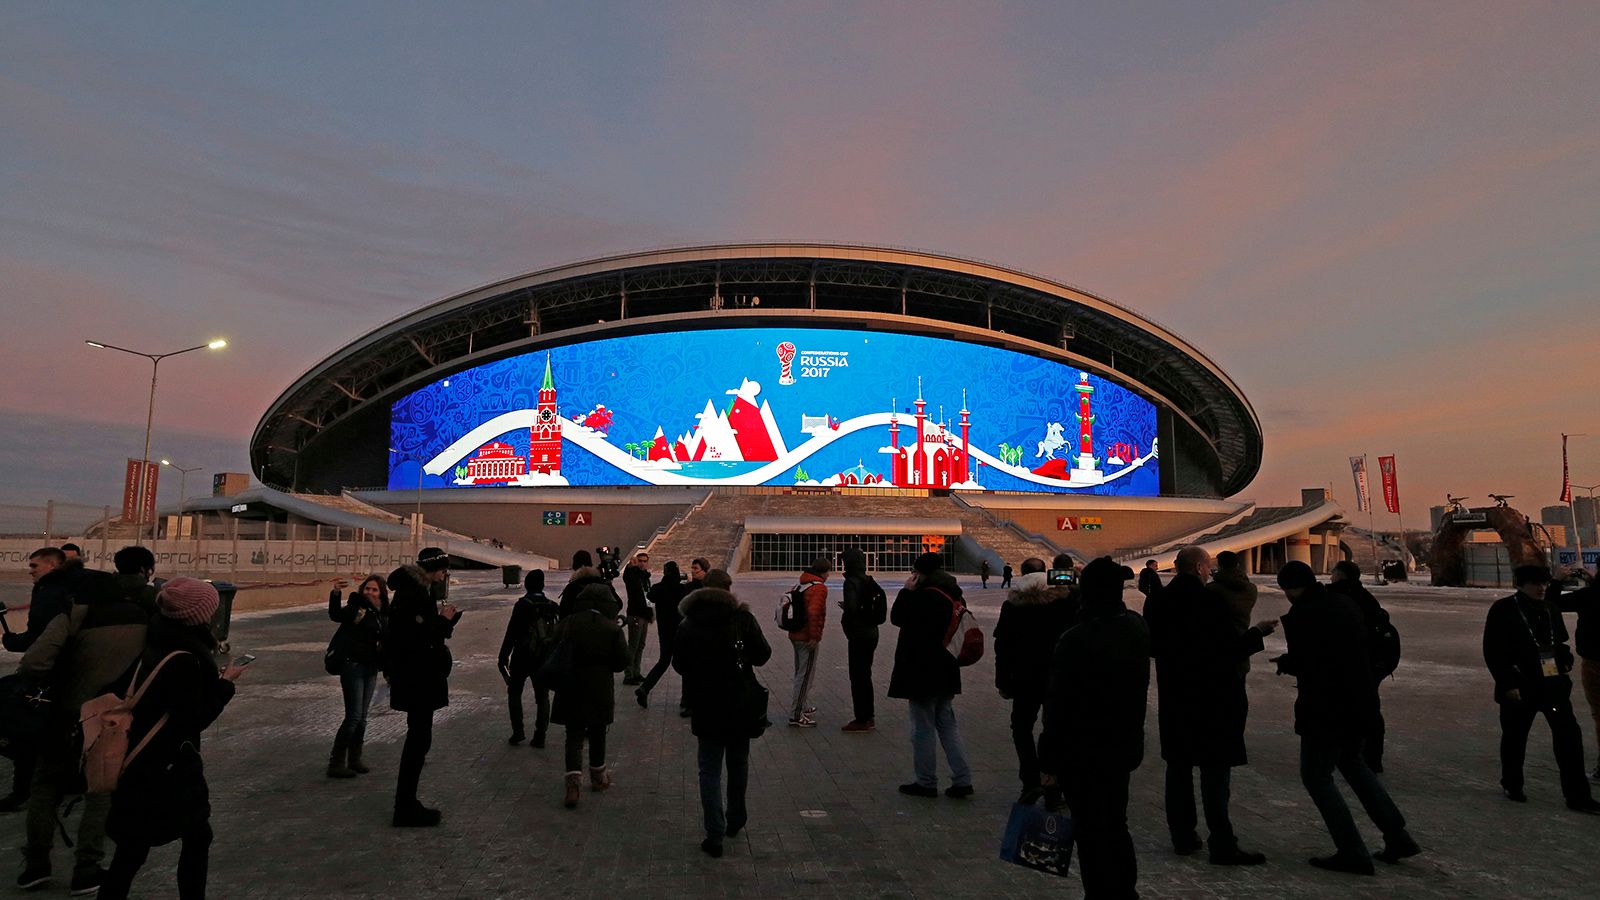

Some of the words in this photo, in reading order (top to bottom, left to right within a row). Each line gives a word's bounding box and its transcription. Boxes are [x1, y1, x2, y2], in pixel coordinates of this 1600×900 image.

[800, 356, 849, 367] RUSSIA
[800, 367, 831, 378] 2017
[575, 513, 585, 524] A
[1061, 517, 1073, 530] A
[273, 553, 416, 566] КАЗАНЬОРГСИНТ
